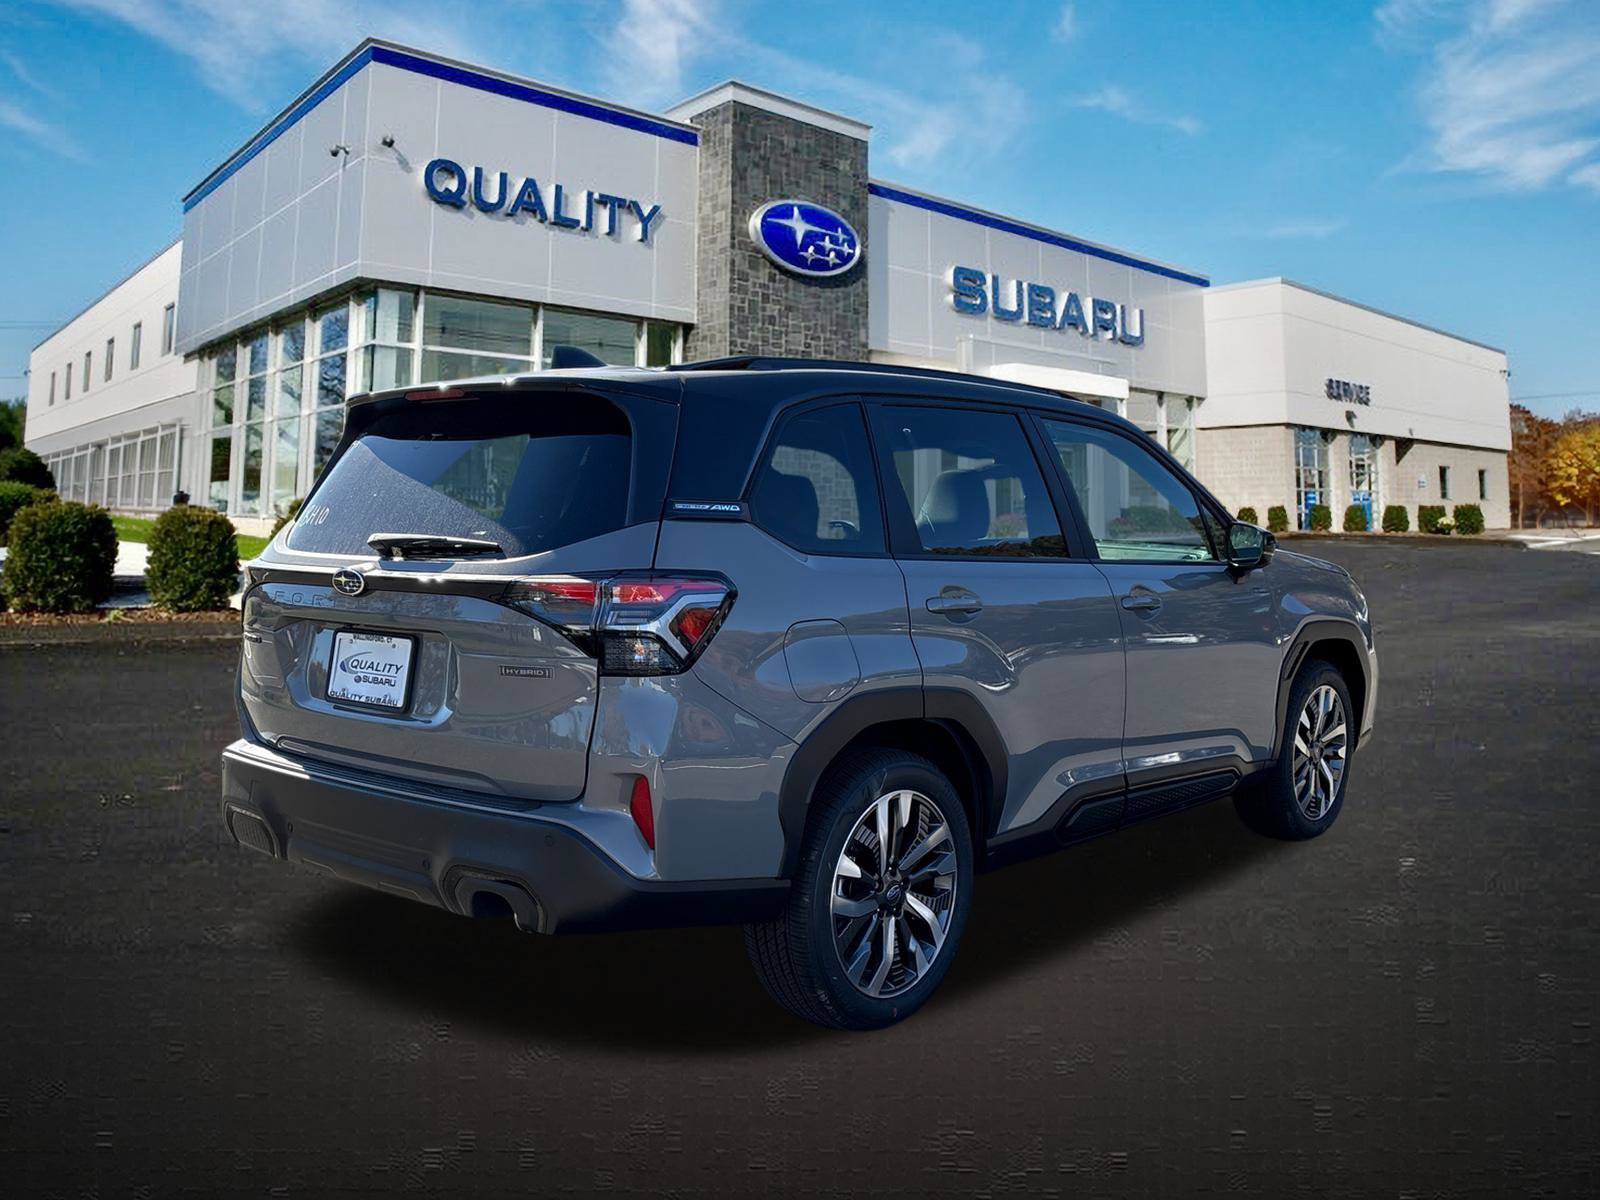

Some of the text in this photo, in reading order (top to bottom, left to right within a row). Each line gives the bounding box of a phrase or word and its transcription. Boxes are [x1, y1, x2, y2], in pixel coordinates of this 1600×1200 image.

[423, 158, 662, 243] QUALITY
[947, 265, 1145, 346] SUBARU
[350, 659, 403, 675] QUALITY
[362, 675, 396, 687] SUBARU
[329, 690, 398, 706] QUALITY SUBARU
